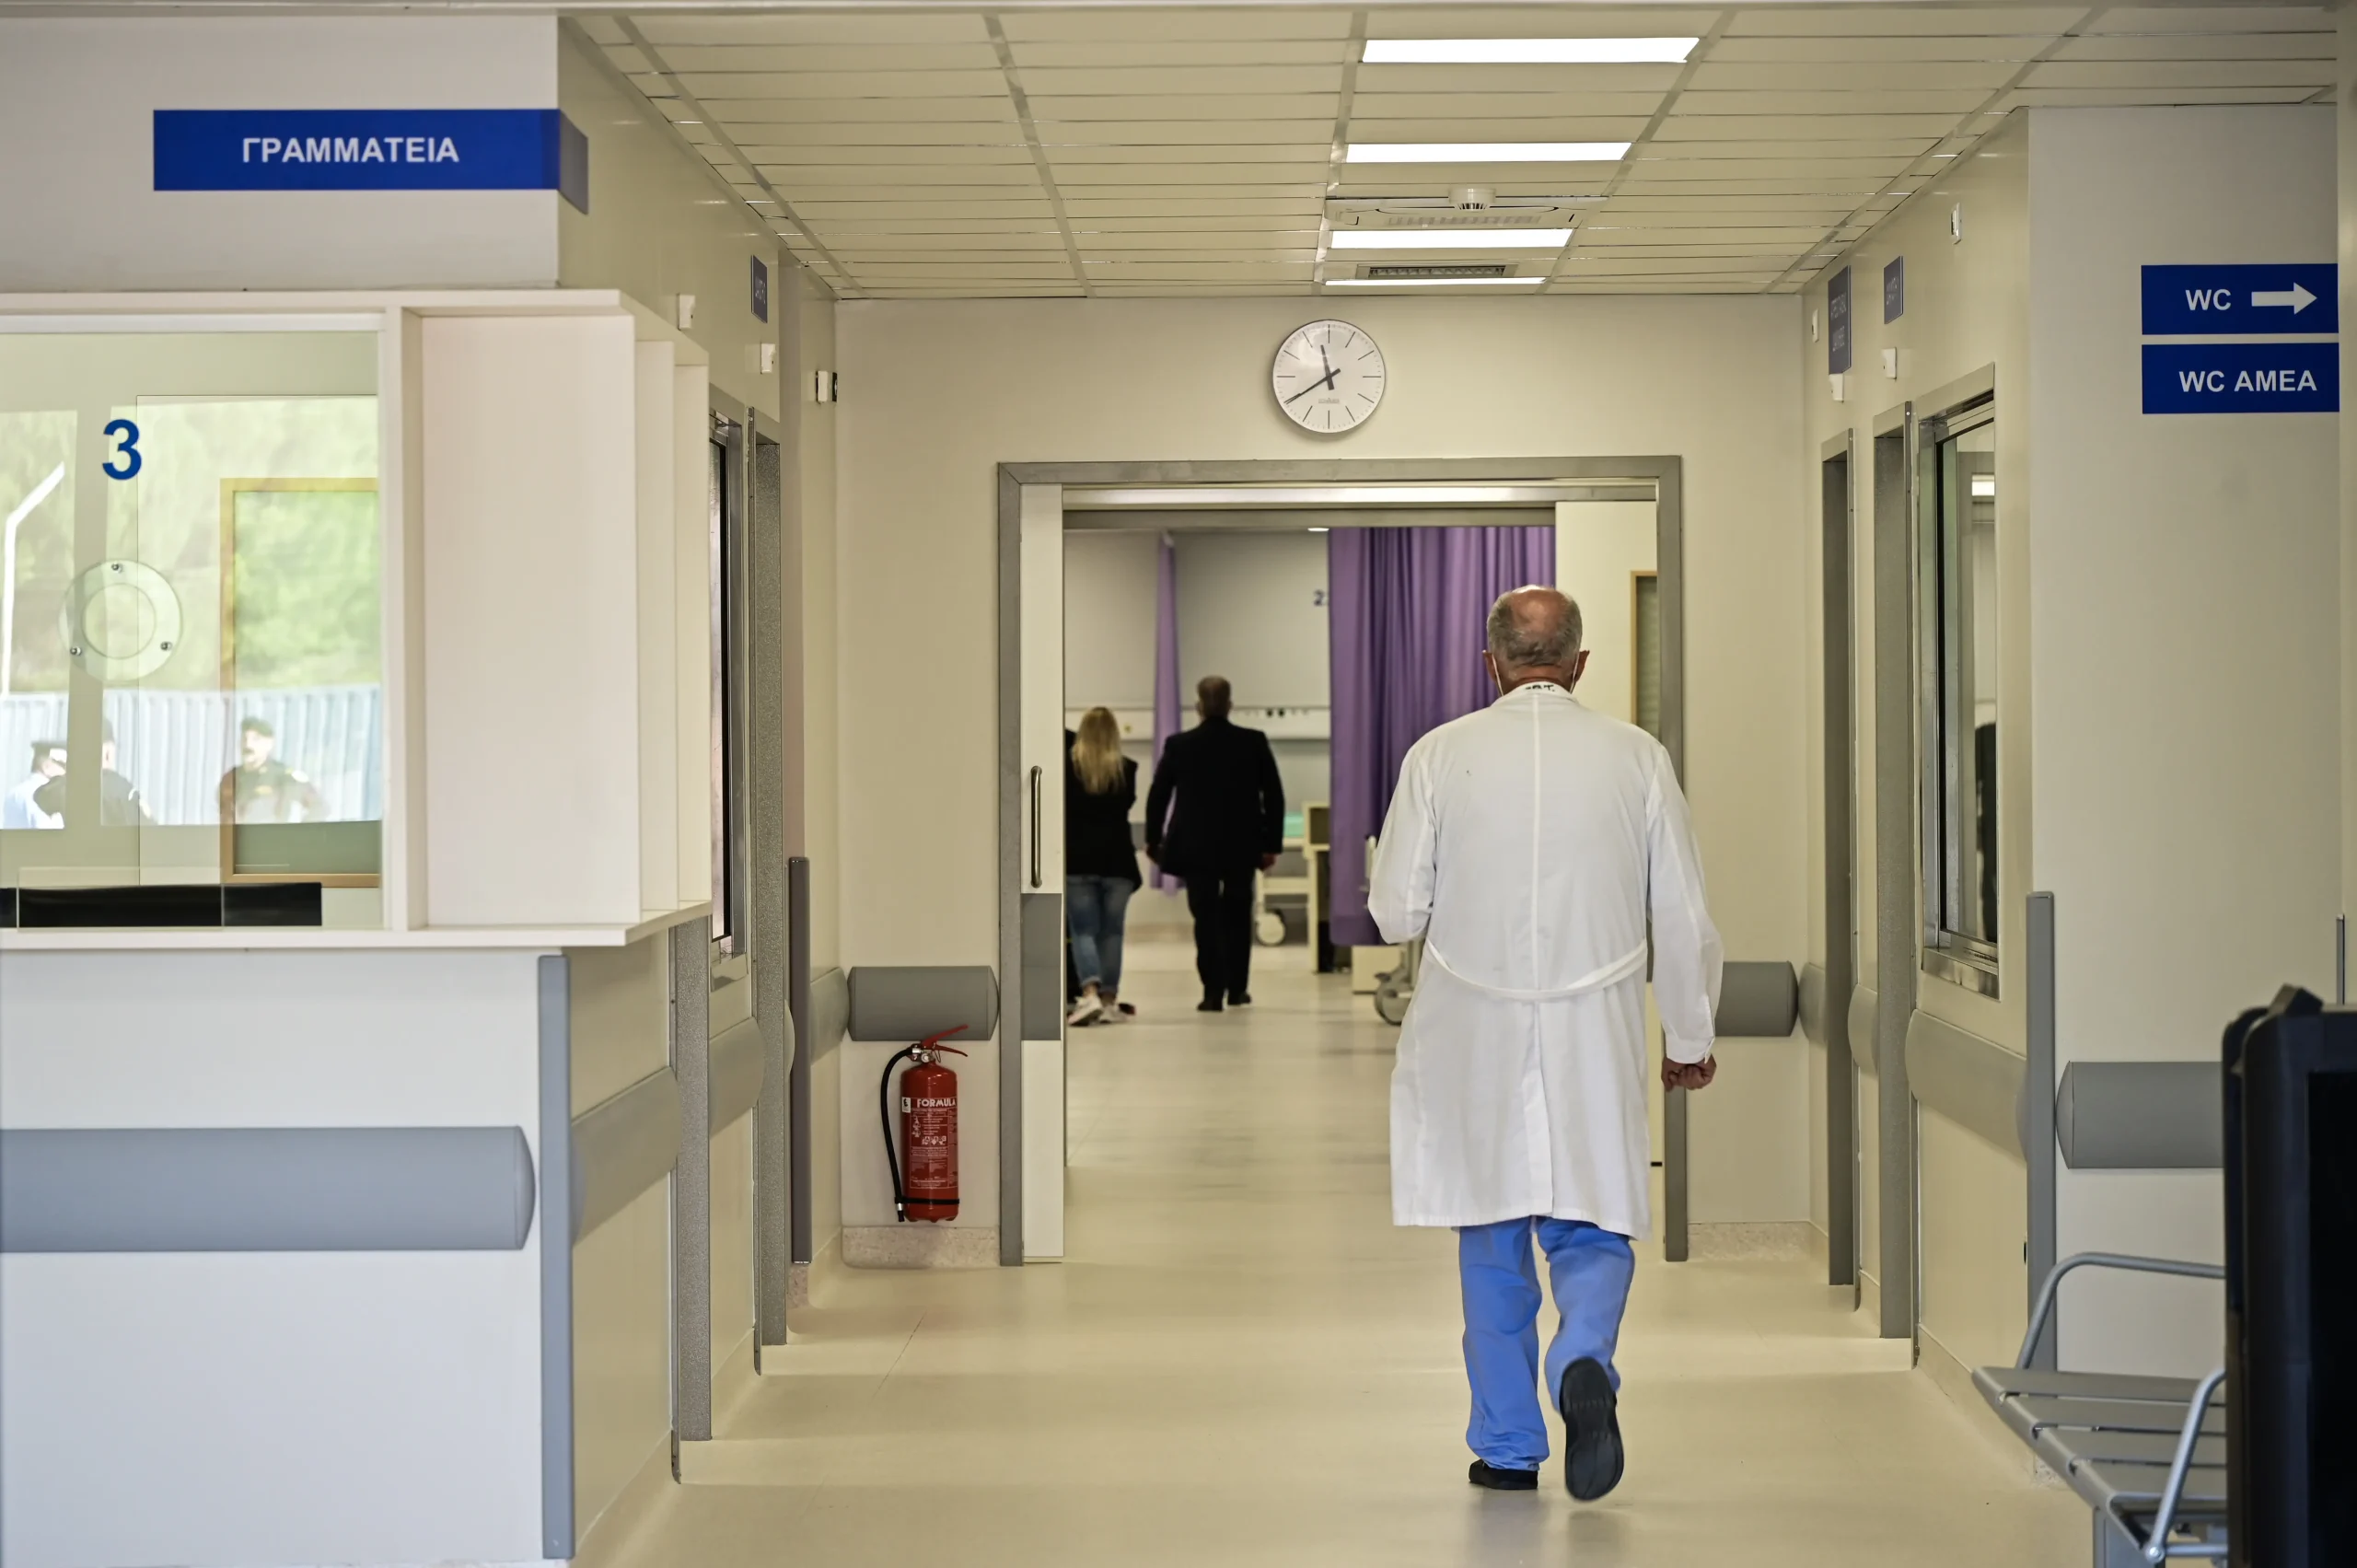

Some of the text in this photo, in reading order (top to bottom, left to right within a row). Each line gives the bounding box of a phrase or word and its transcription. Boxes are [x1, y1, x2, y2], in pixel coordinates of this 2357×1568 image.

[242, 137, 459, 163] ΓΡΑΜΜΑΤΕΙΑ
[2185, 288, 2232, 311] WC
[2178, 370, 2224, 392] WC
[102, 419, 142, 480] 3
[917, 1098, 956, 1108] FORMULA
